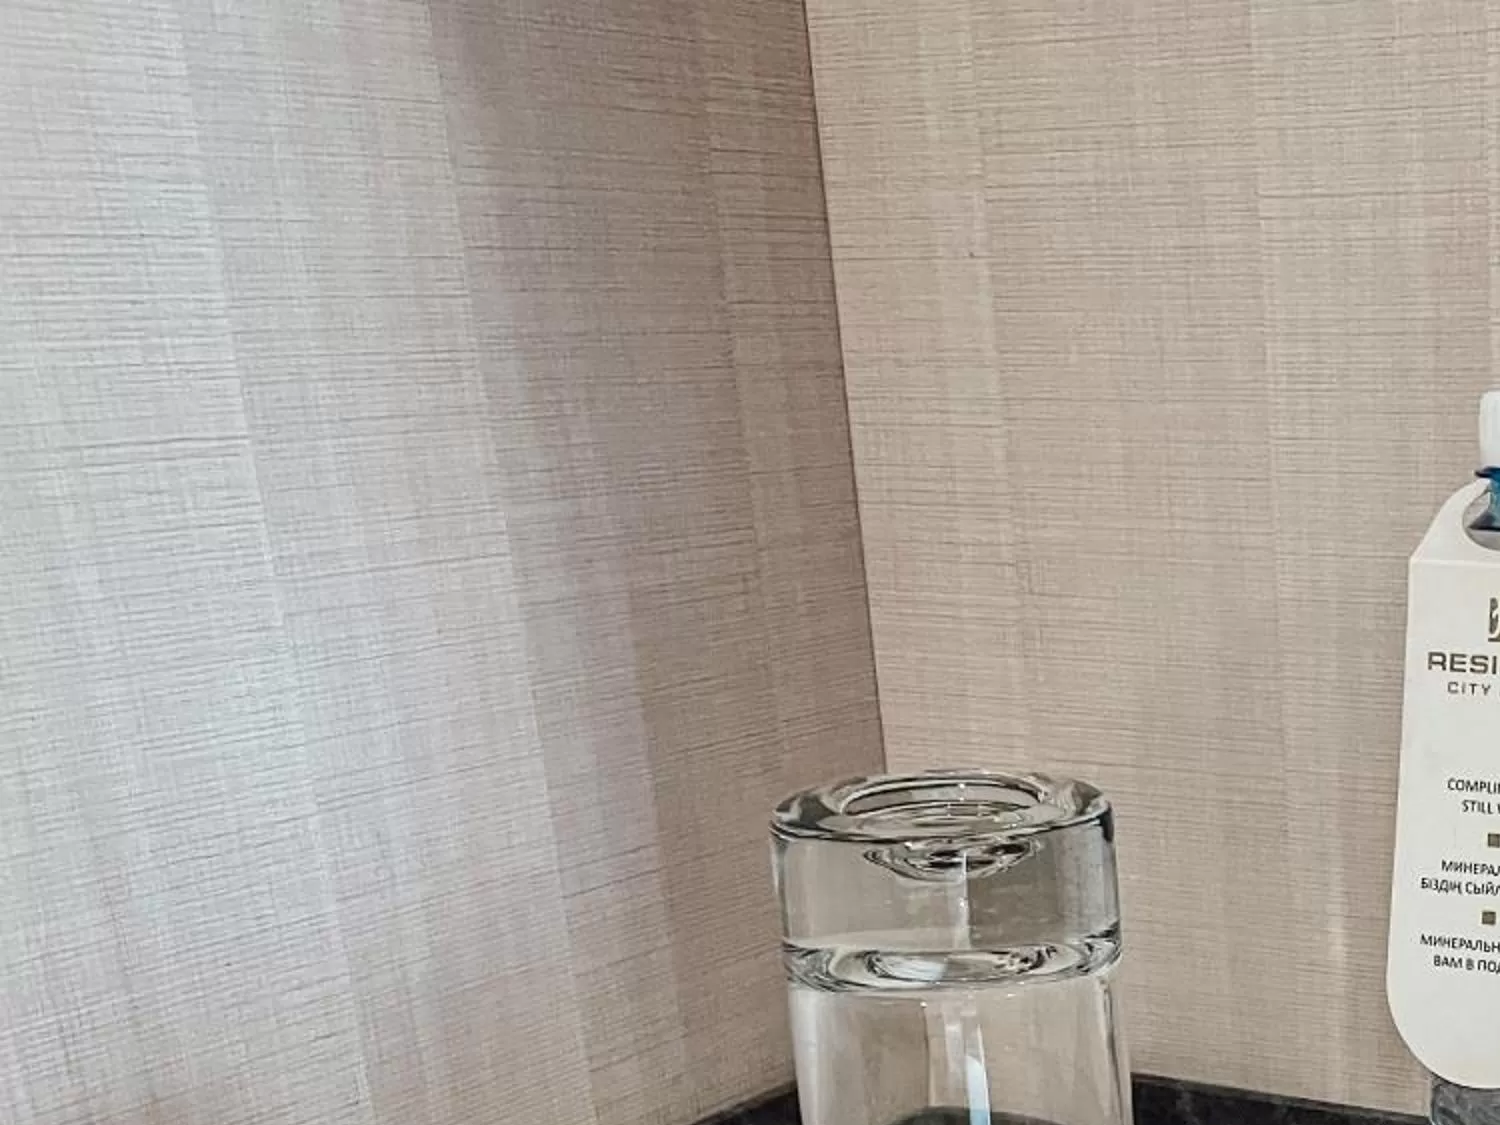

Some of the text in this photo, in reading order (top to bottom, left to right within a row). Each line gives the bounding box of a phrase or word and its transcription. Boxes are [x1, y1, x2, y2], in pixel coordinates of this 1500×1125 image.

[1447, 681, 1492, 696] CITY
[1461, 799, 1494, 815] STILL
[1433, 955, 1463, 969] ВАМ
[1465, 958, 1475, 971] В
